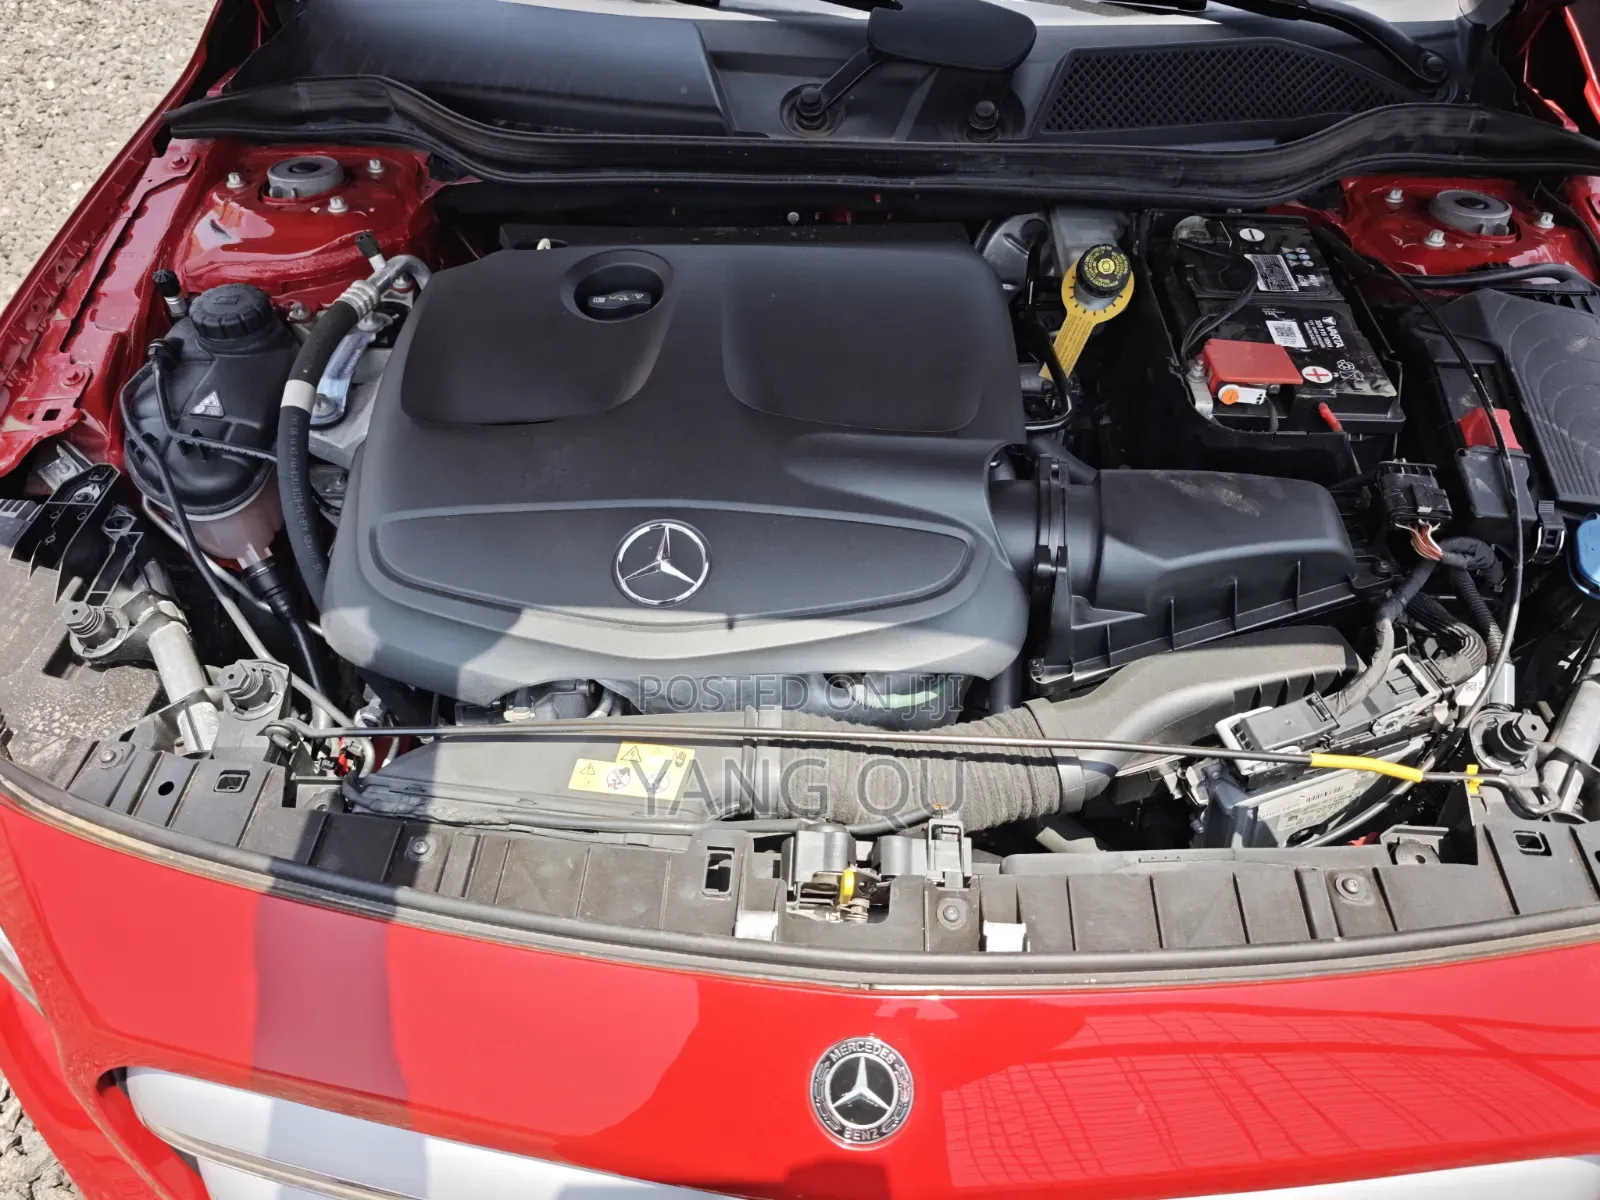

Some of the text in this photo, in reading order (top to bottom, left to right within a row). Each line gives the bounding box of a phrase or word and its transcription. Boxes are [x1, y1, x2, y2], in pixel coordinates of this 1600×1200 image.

[1326, 326, 1345, 348] VARTA
[829, 1041, 896, 1065] MERCEDES
[843, 1127, 880, 1140] BENZ
